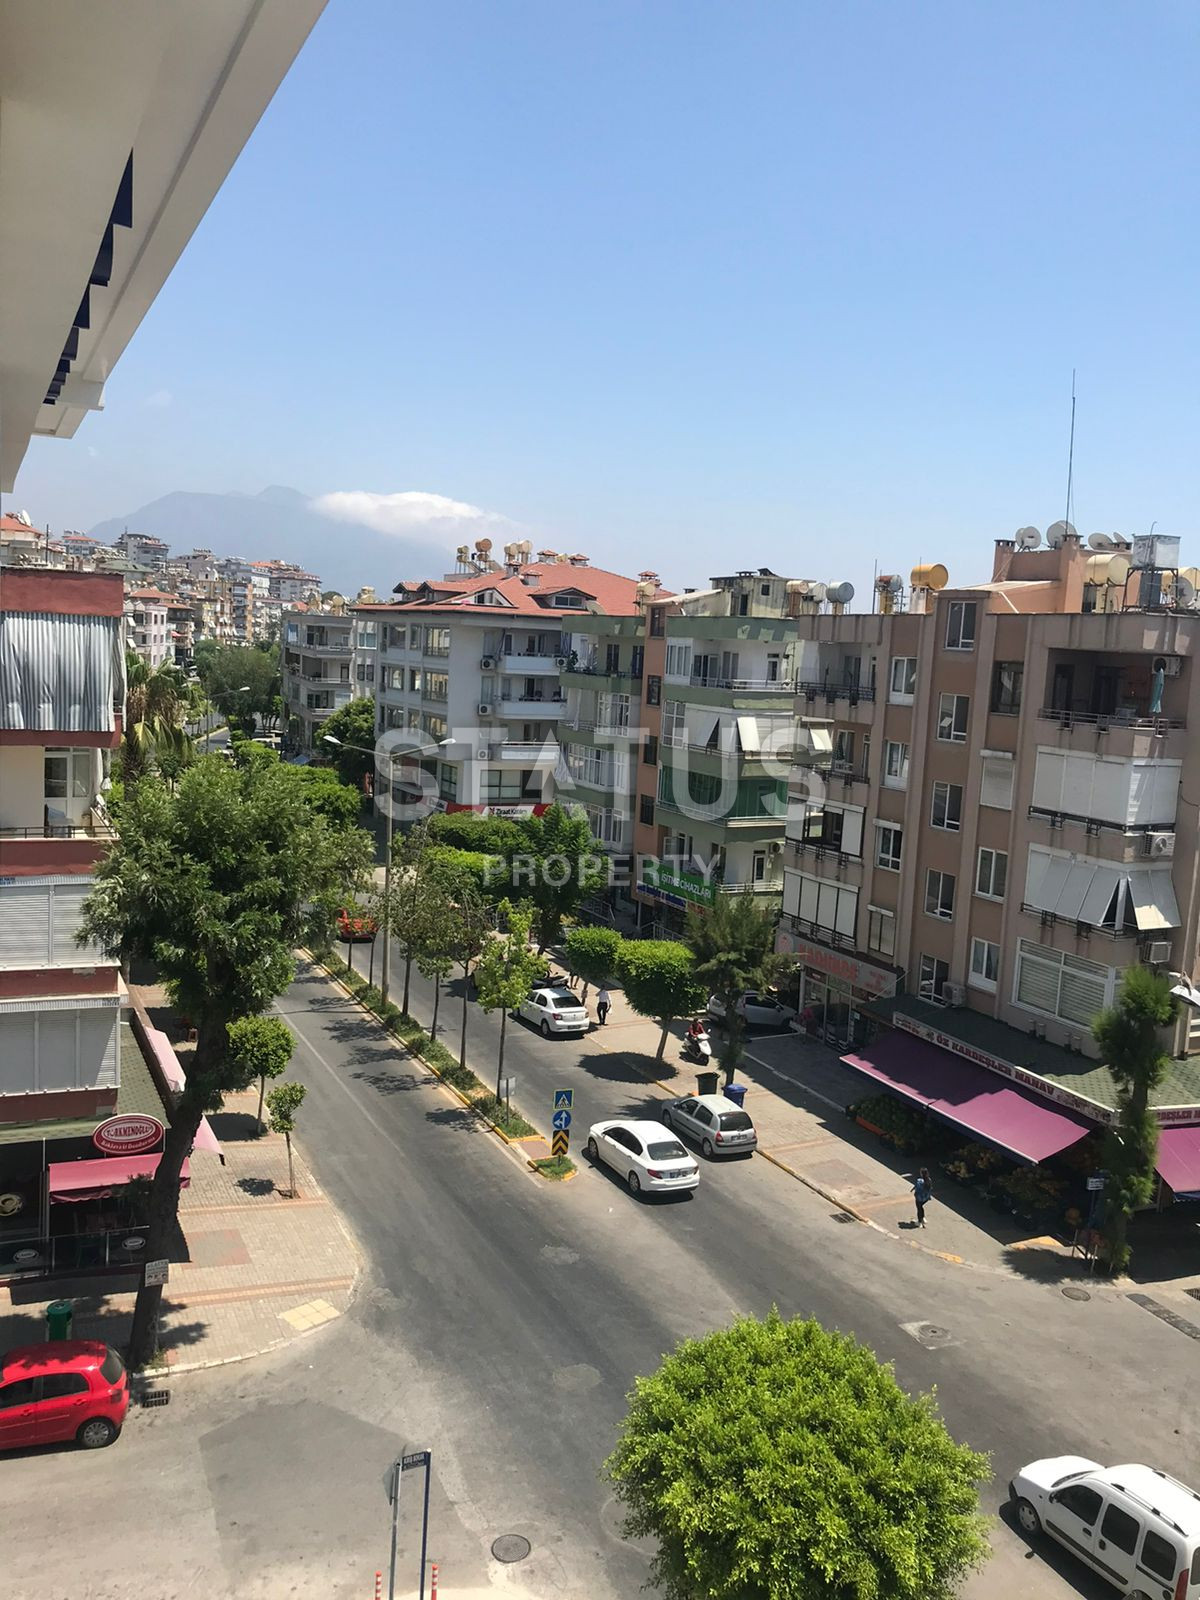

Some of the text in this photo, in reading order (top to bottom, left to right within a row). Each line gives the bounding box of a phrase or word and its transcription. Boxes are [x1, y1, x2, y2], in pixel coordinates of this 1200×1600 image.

[936, 1034, 1055, 1096] ÖZ KARDEŞLER MANAV
